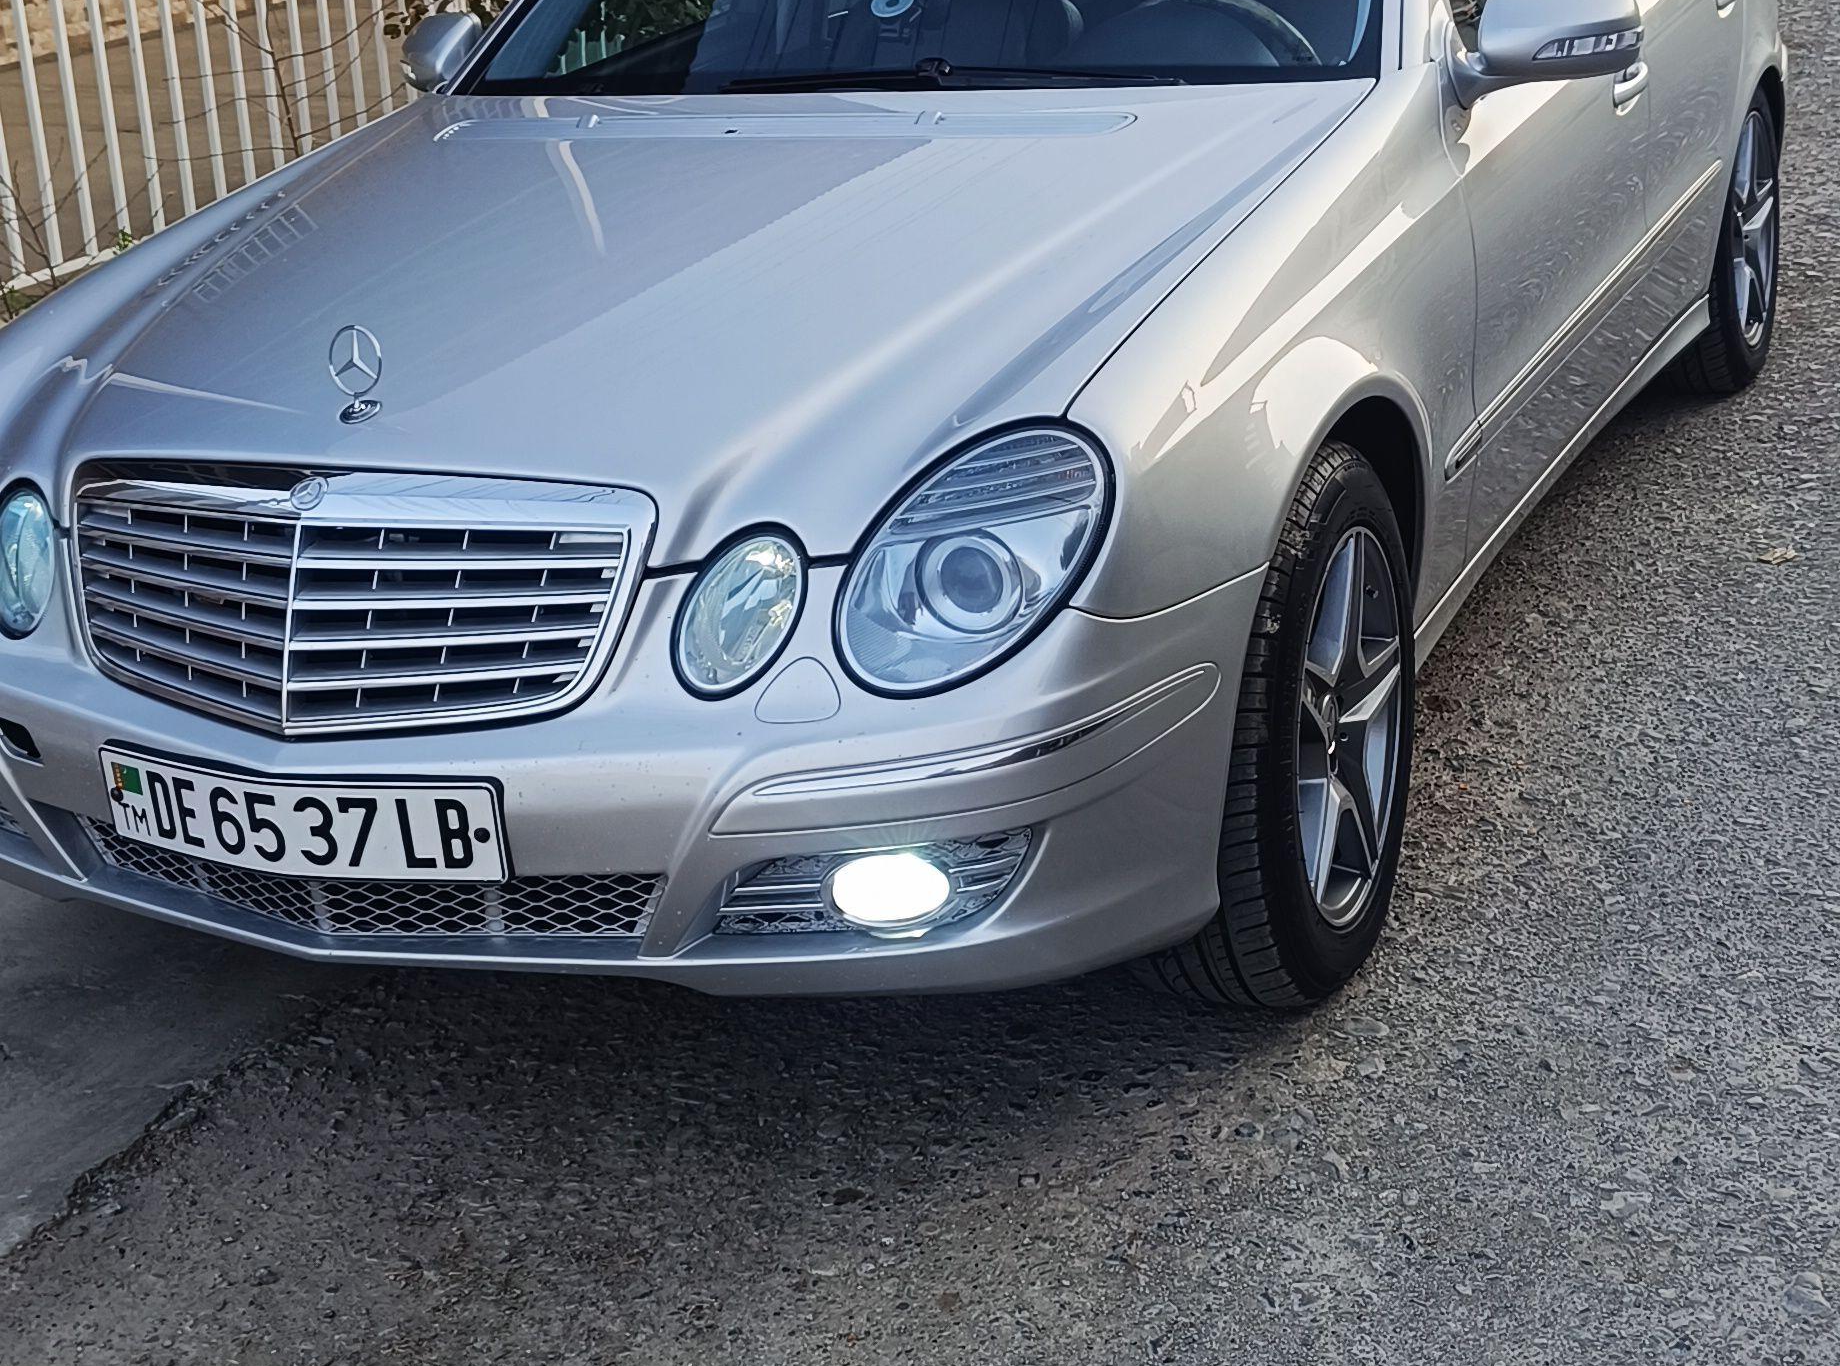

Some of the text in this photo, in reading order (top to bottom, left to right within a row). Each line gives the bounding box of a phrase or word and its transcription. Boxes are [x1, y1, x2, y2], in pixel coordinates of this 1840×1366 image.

[118, 802, 151, 837] TM
[146, 770, 206, 849] DE
[395, 798, 475, 869] LB
